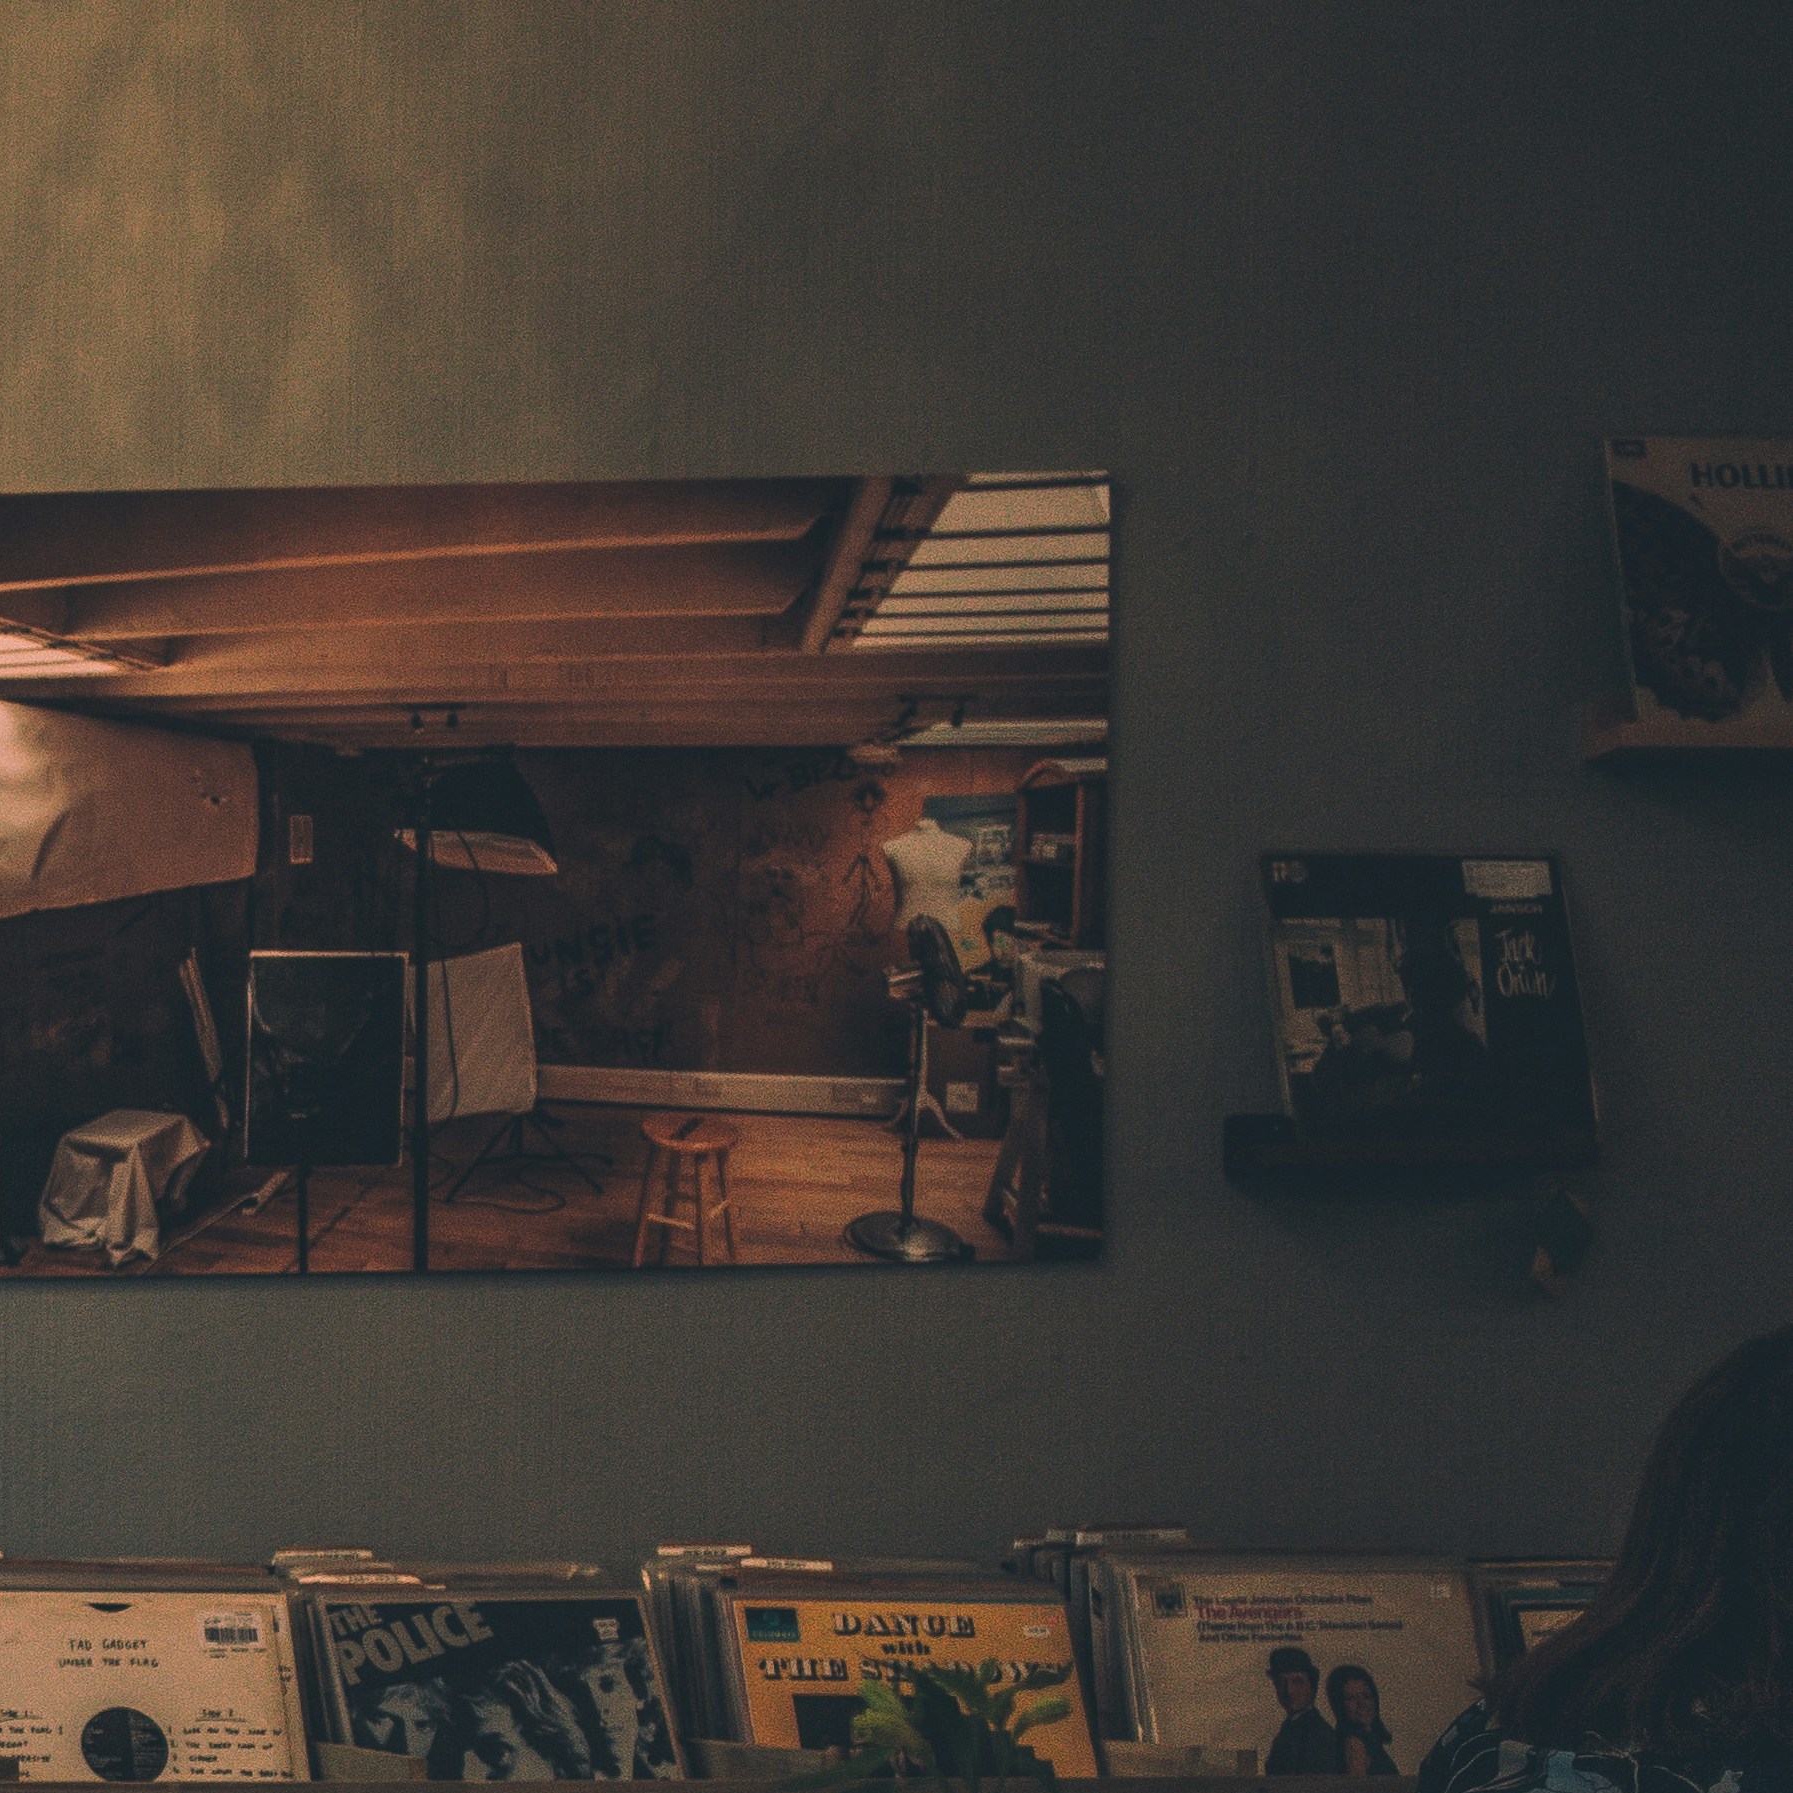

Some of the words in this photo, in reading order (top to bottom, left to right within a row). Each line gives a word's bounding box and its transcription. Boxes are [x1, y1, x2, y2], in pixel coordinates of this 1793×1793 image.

[1689, 461, 1793, 491] HOLLI
[328, 1604, 382, 1636] THE
[831, 1612, 976, 1639] DANCE
[1197, 1605, 1227, 1620] The
[1230, 1605, 1303, 1623] Avengers
[335, 1601, 494, 1686] POLICE
[880, 1640, 932, 1656] with
[758, 1658, 849, 1682] THE
